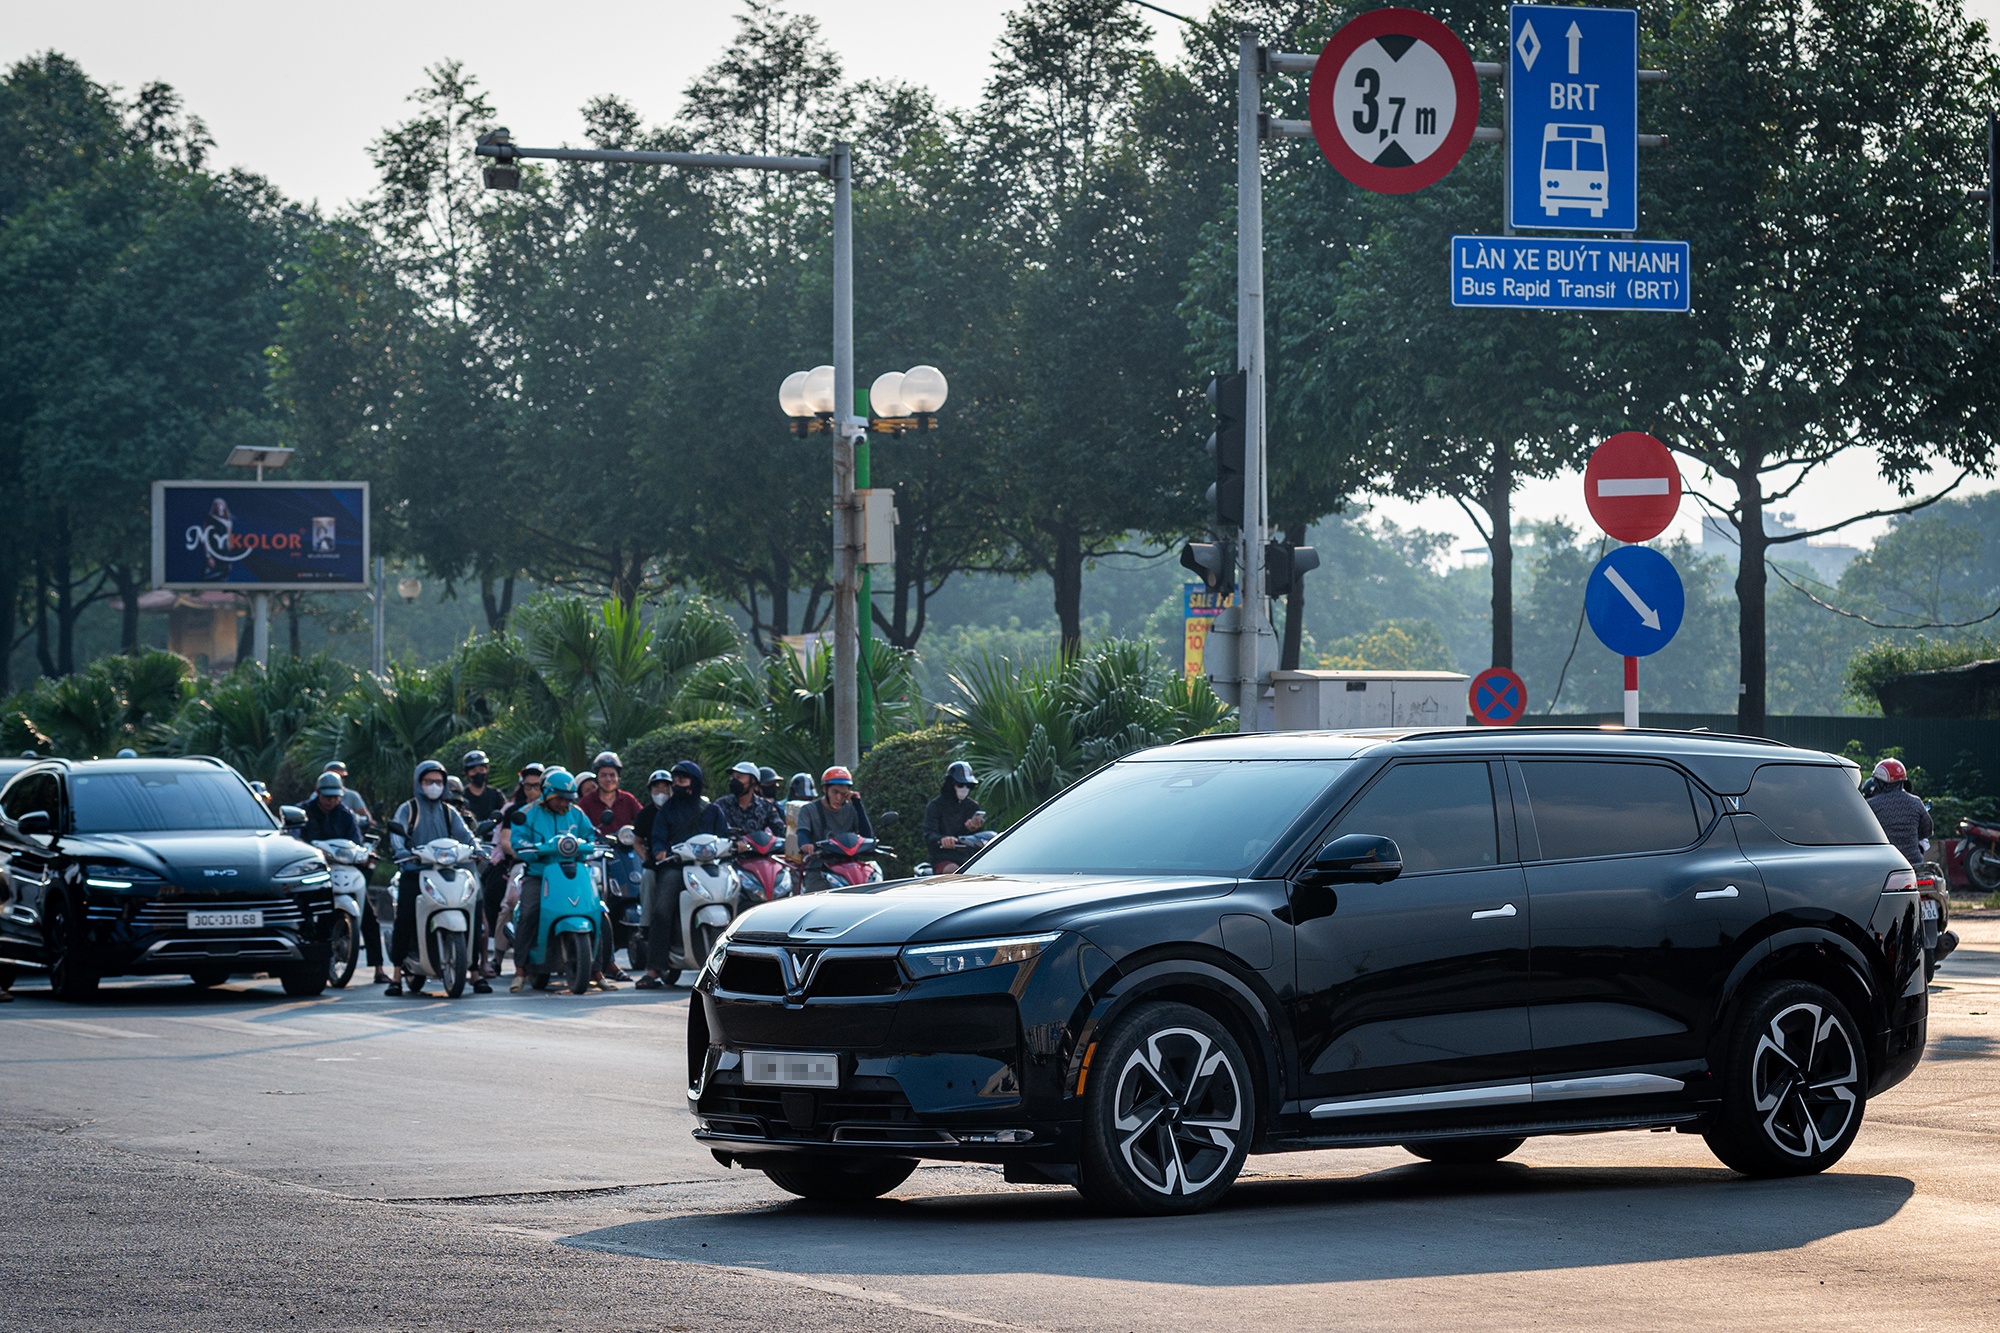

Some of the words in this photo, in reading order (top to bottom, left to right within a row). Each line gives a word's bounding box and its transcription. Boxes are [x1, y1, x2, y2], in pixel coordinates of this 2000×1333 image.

[1353, 67, 1406, 144] 3,7
[1415, 107, 1436, 135] m
[1550, 82, 1600, 111] BRT
[1461, 242, 1505, 270] LÀN
[1513, 248, 1540, 271] XE
[1547, 245, 1601, 272] BUÝT
[1609, 251, 1680, 274] NHANH
[1461, 277, 1496, 296] Bus
[1503, 278, 1550, 301] Rapid
[1558, 279, 1617, 299] Transit
[1627, 279, 1680, 300] (BRT)
[1189, 593, 1213, 608] SALE
[203, 869, 238, 877] BYD
